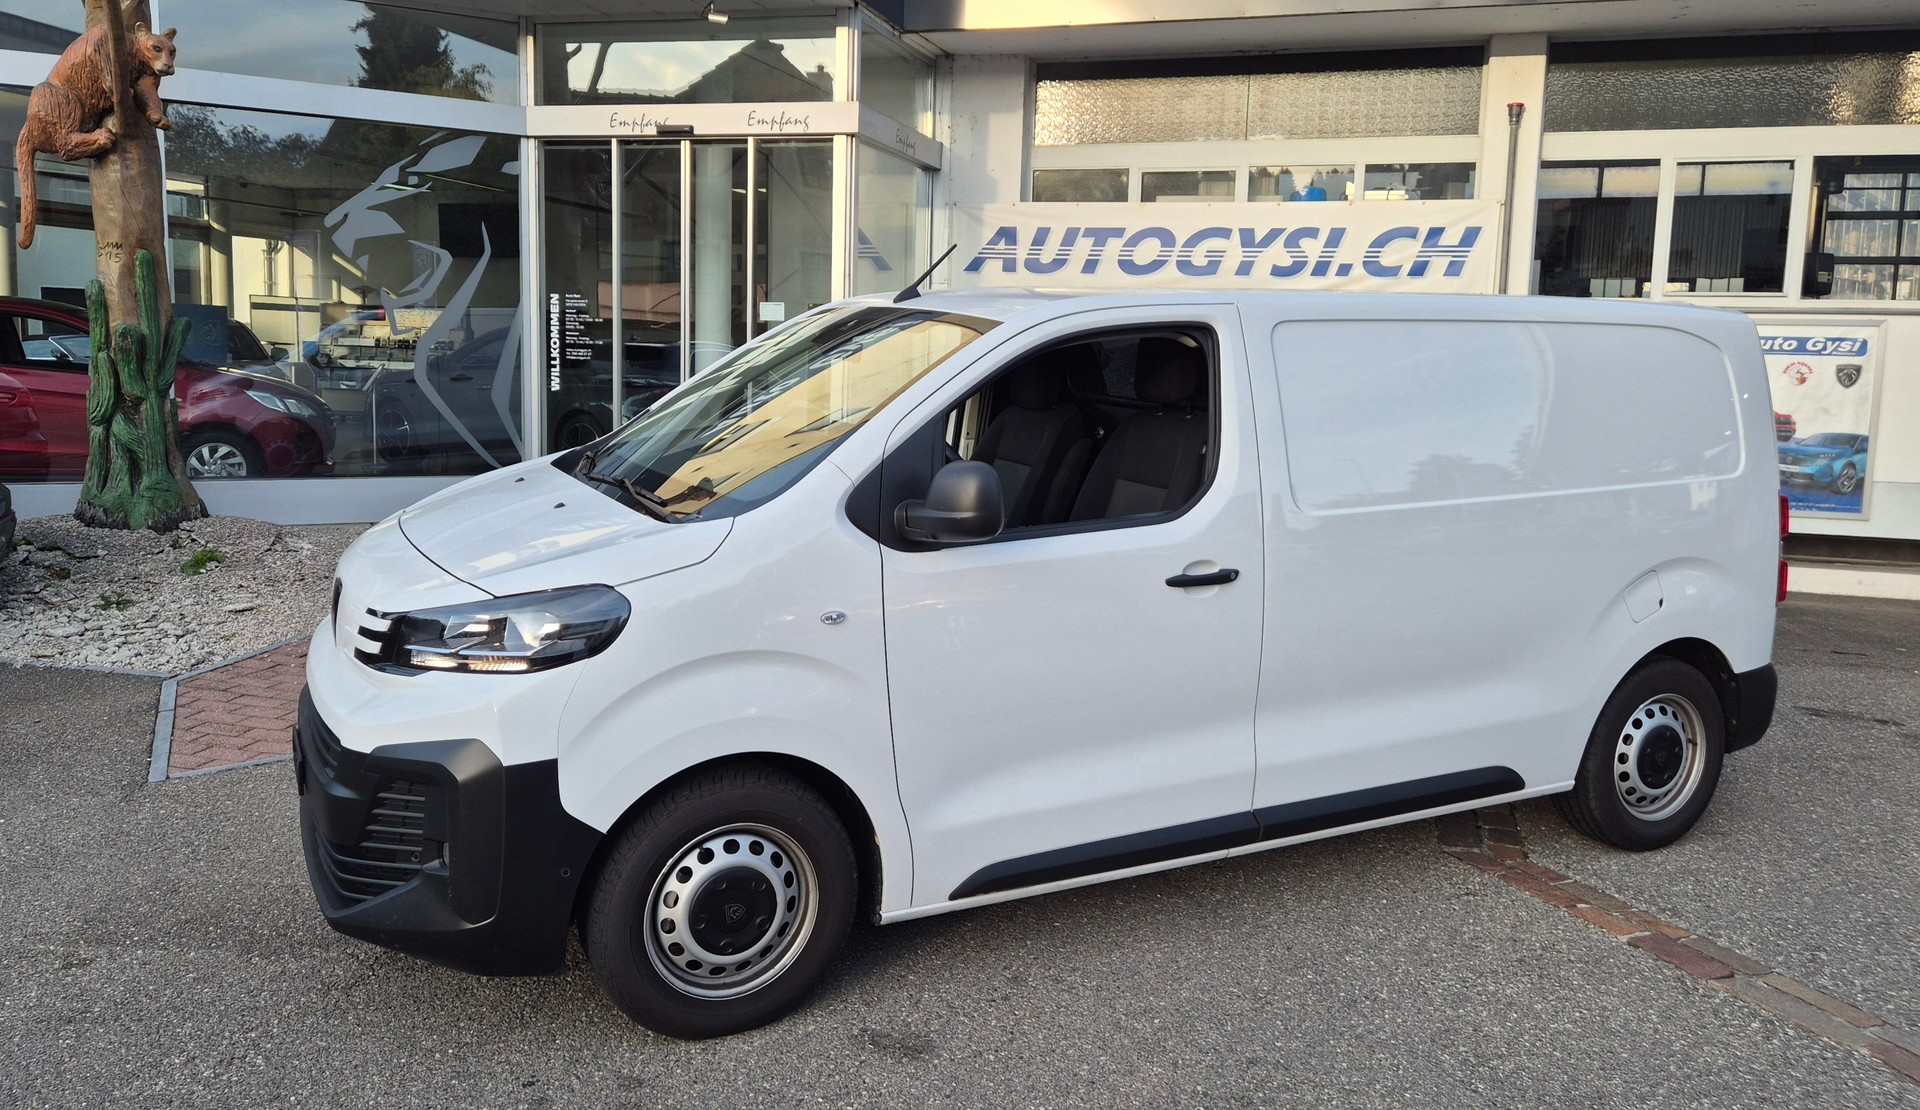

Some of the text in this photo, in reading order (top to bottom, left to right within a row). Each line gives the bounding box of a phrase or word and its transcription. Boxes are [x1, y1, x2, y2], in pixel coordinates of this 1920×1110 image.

[747, 110, 810, 132] Empfang
[963, 225, 1483, 279] AUTOGYSI.CH
[549, 293, 561, 392] WILLKOMMEN
[1760, 337, 1863, 354] uto Gysi
